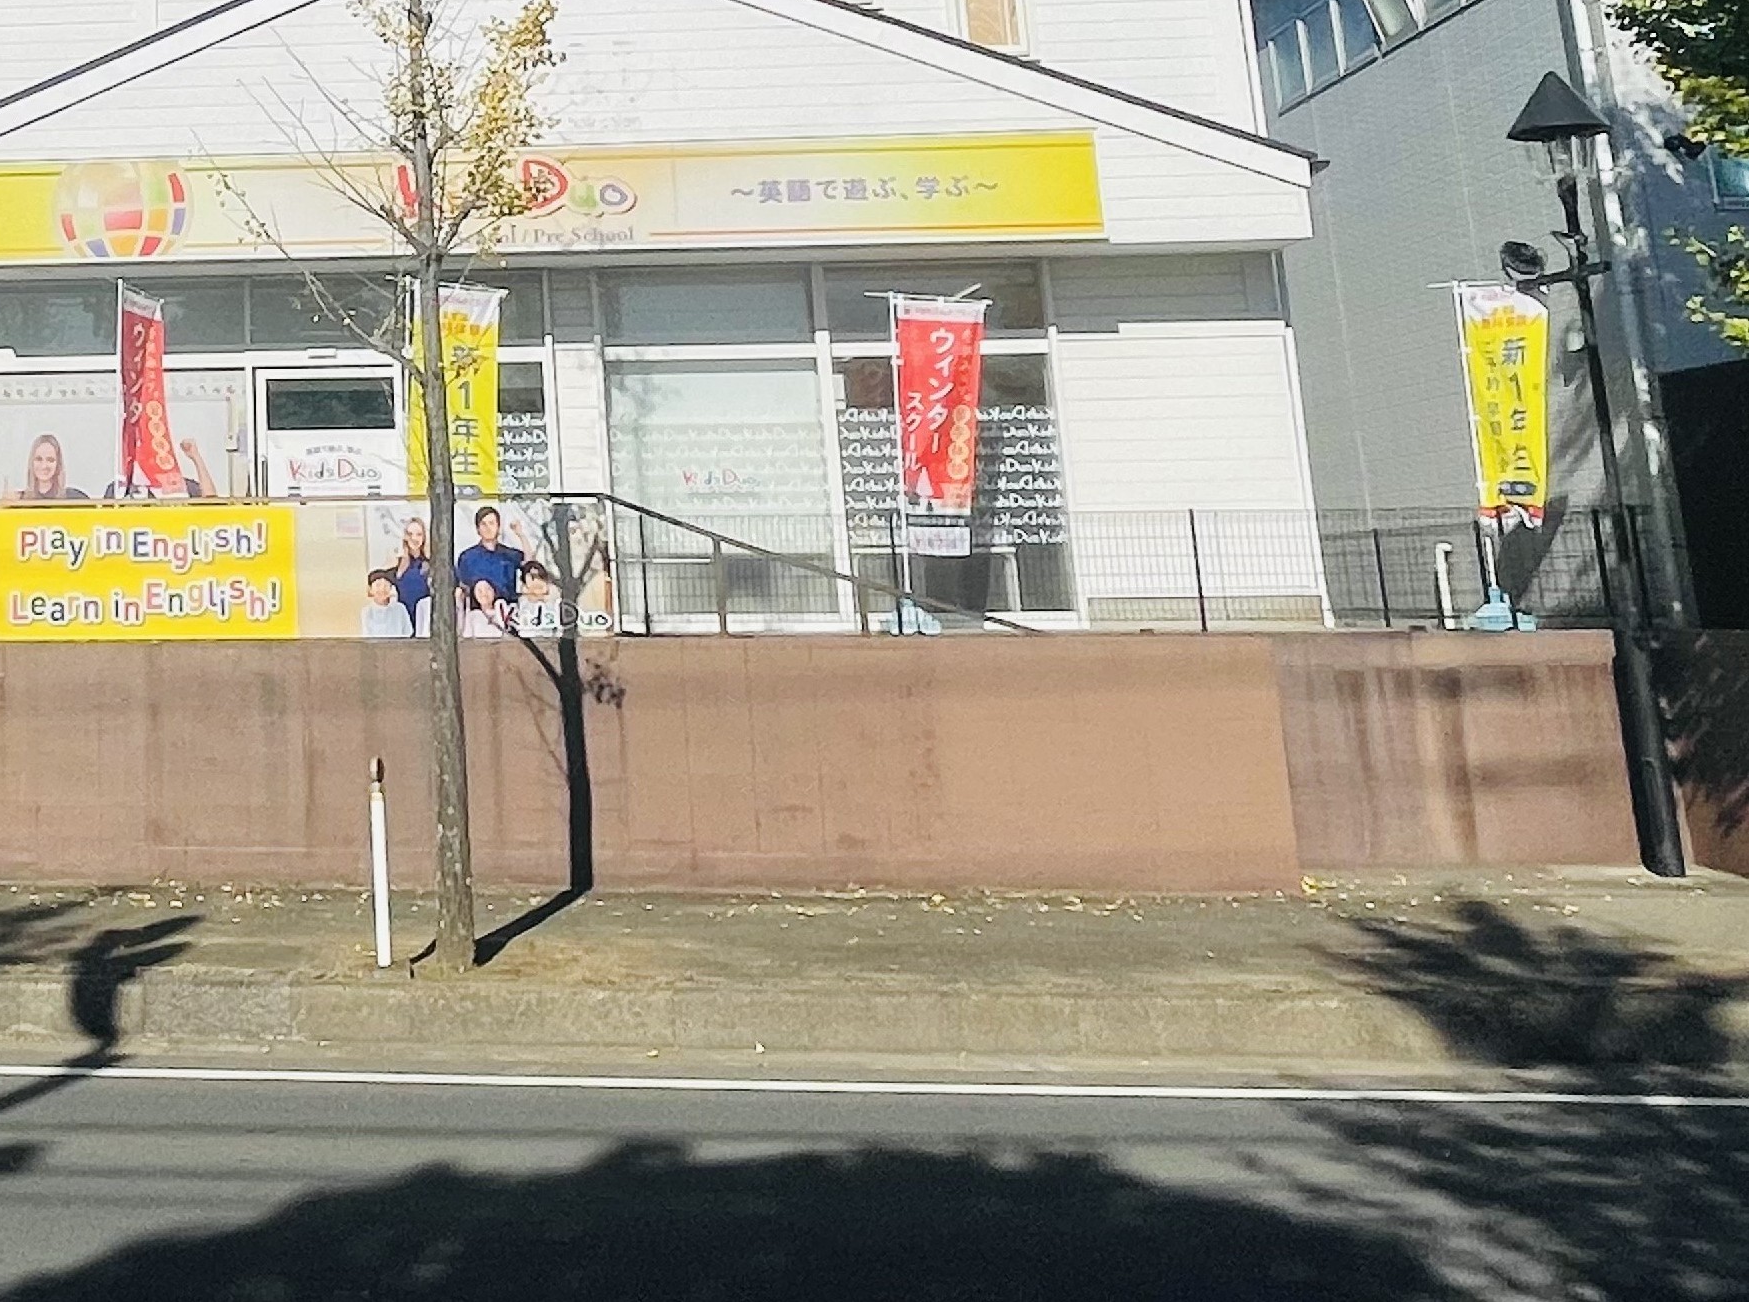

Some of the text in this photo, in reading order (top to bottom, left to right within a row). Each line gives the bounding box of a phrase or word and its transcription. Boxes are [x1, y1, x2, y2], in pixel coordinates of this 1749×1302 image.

[571, 226, 634, 242] School
[928, 327, 955, 454] ウィンター
[905, 391, 925, 472] スクール
[19, 522, 264, 569] Play in English!
[12, 579, 277, 622] Learn in English!
